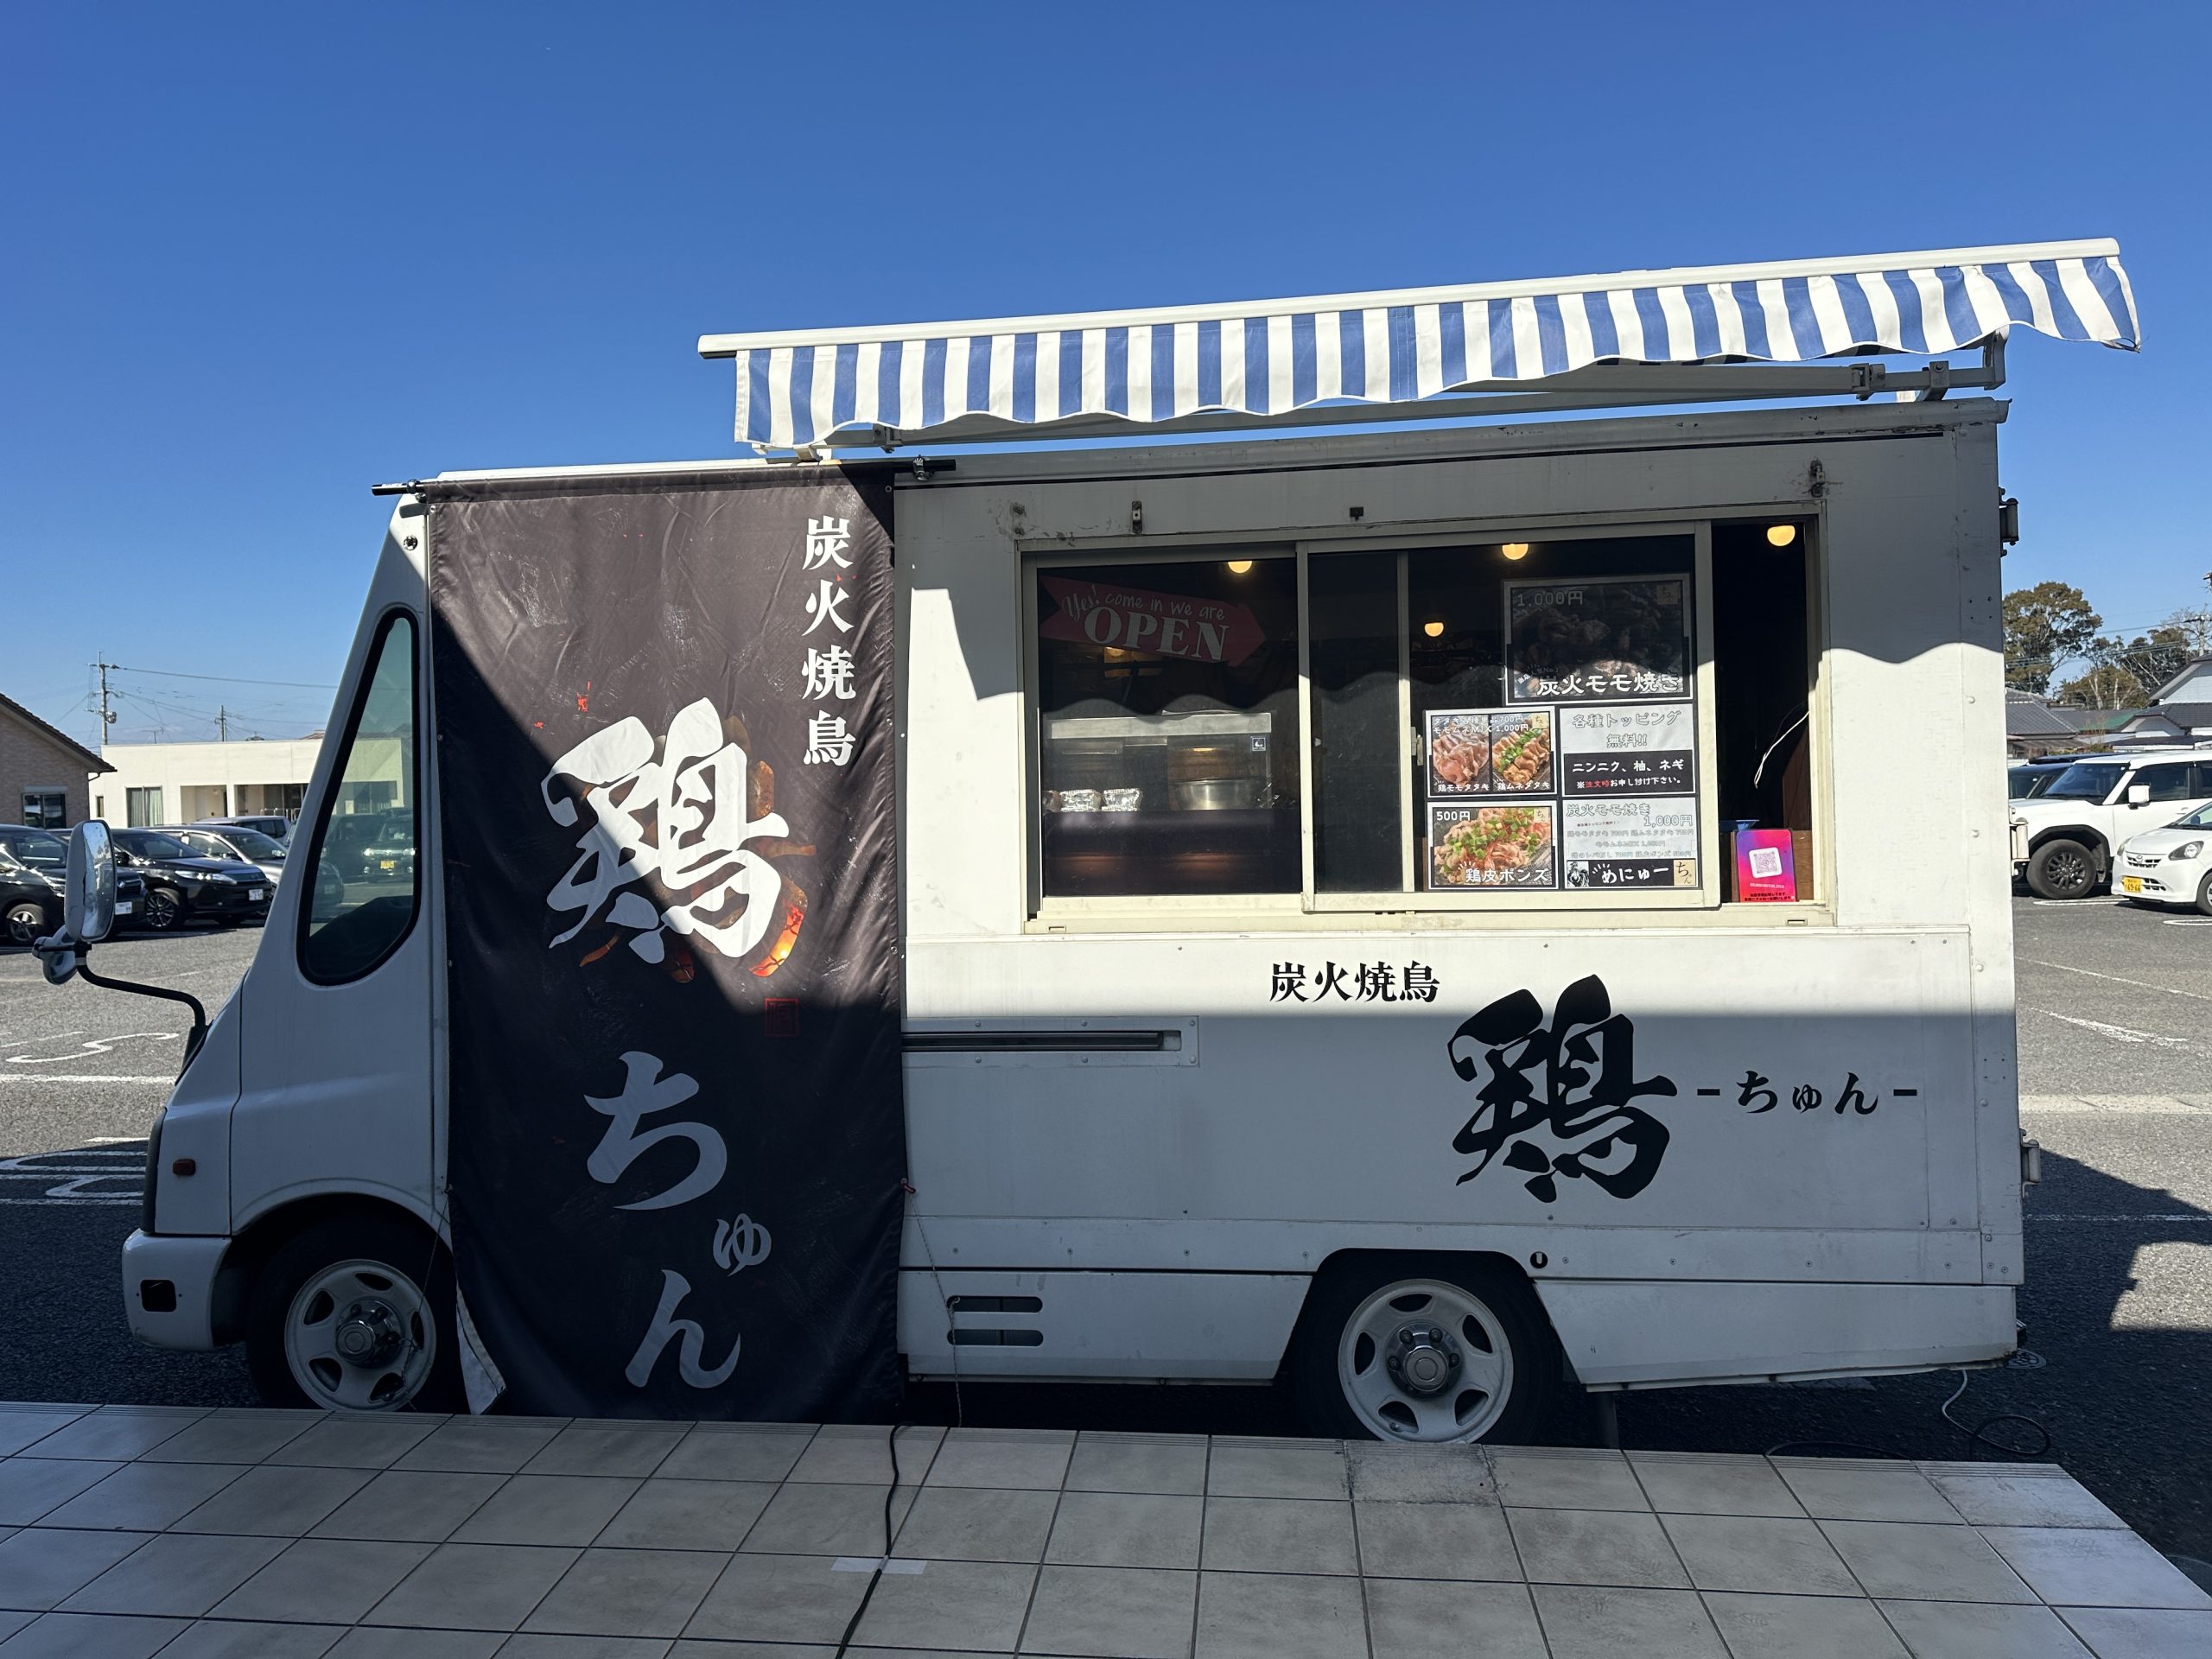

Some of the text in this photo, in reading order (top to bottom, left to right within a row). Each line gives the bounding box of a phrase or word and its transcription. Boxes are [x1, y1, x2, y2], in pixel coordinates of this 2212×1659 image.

[1061, 584, 1100, 622] Yes!
[1105, 593, 1143, 609] come
[1150, 595, 1162, 612] in
[1198, 606, 1225, 620] are
[802, 515, 856, 767] 炭火焼鳥
[1084, 606, 1230, 663] OPEN
[1536, 671, 1679, 696] 炭火モモ焼き
[1573, 710, 1681, 728] 各種トッピング
[1436, 810, 1471, 822] 500円
[1566, 803, 1651, 817] 炭火モモ焼き
[1643, 814, 1694, 828] 1,000円
[1465, 868, 1549, 883] 鶏皮ポンズ
[1601, 867, 1669, 884] めにゅー
[1269, 960, 1440, 1003] 炭火焼鳥
[583, 1051, 772, 1389] ちゅん
